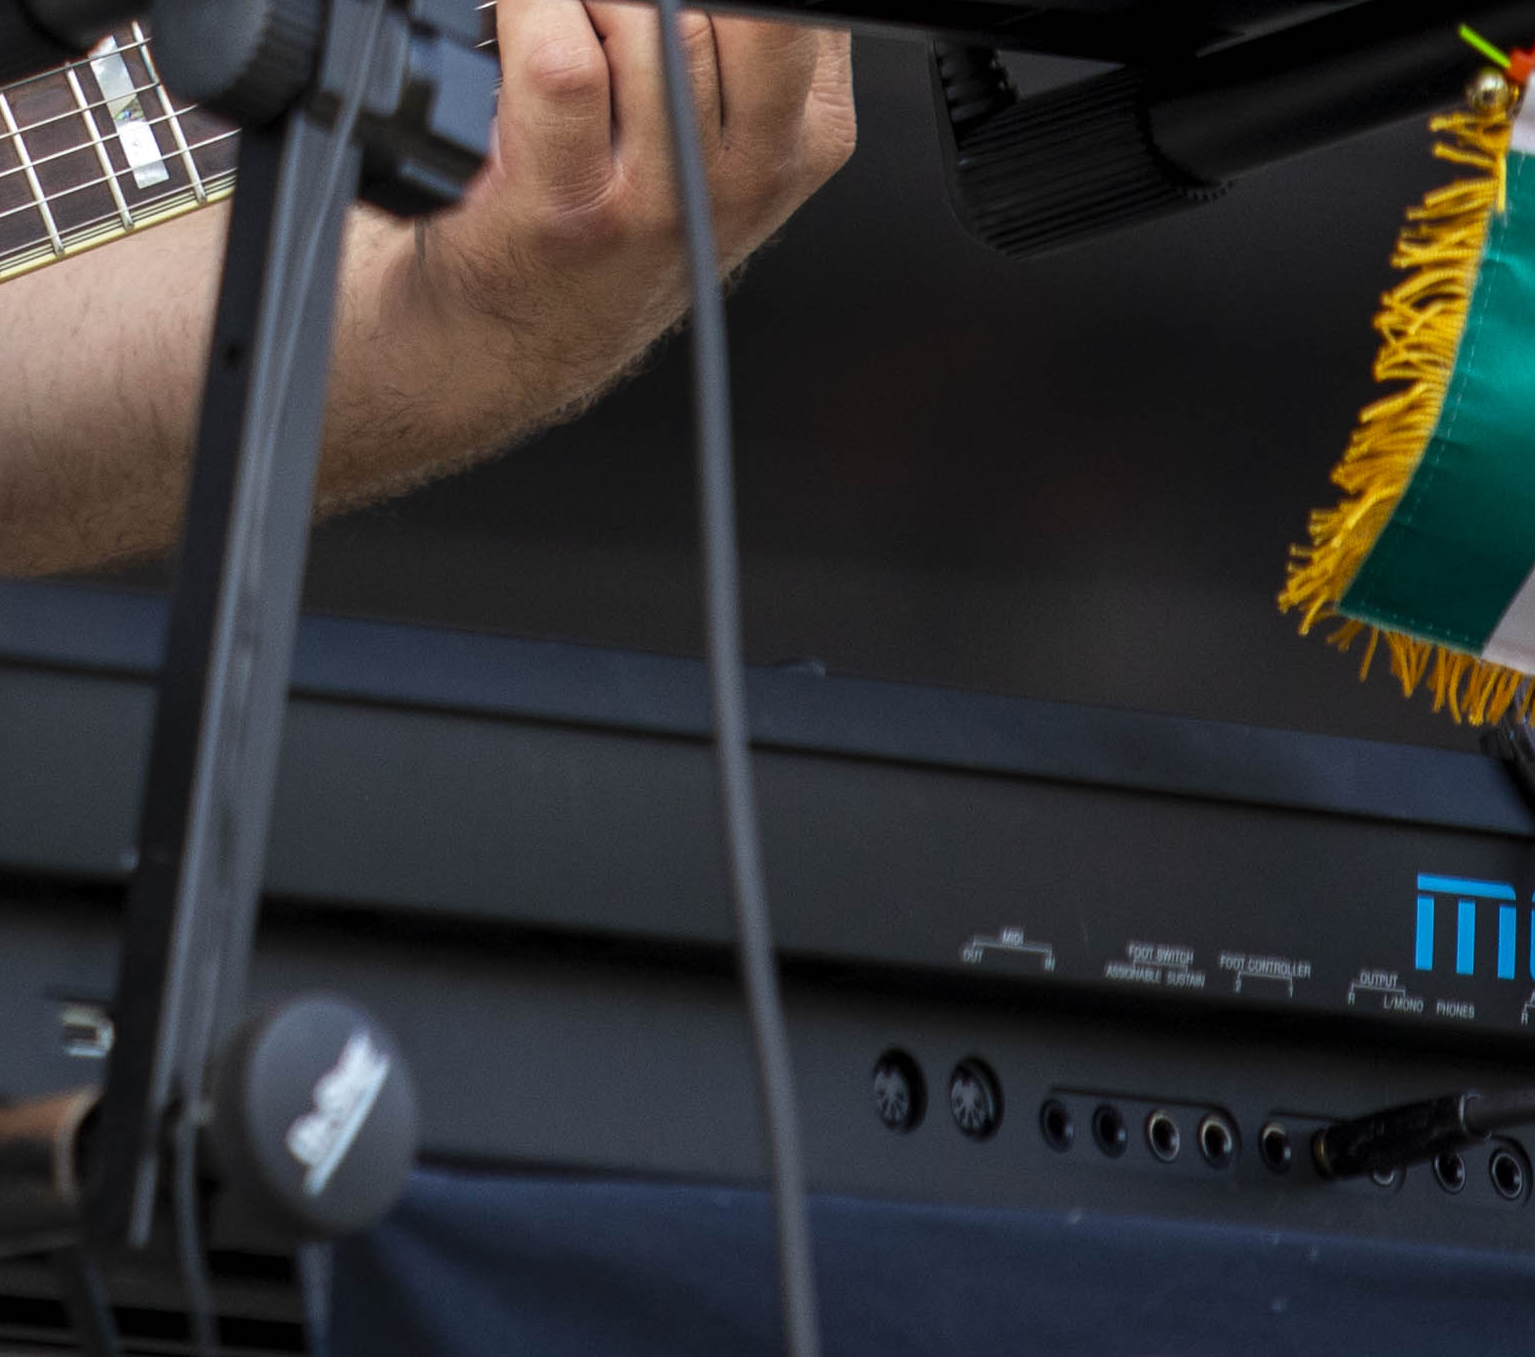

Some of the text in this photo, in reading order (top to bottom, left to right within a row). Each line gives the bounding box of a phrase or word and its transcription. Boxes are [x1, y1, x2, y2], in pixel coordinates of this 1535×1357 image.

[1359, 970, 1399, 988] OUTPUT
[1382, 993, 1425, 1014] L/MONO
[1435, 999, 1475, 1019] PHONES
